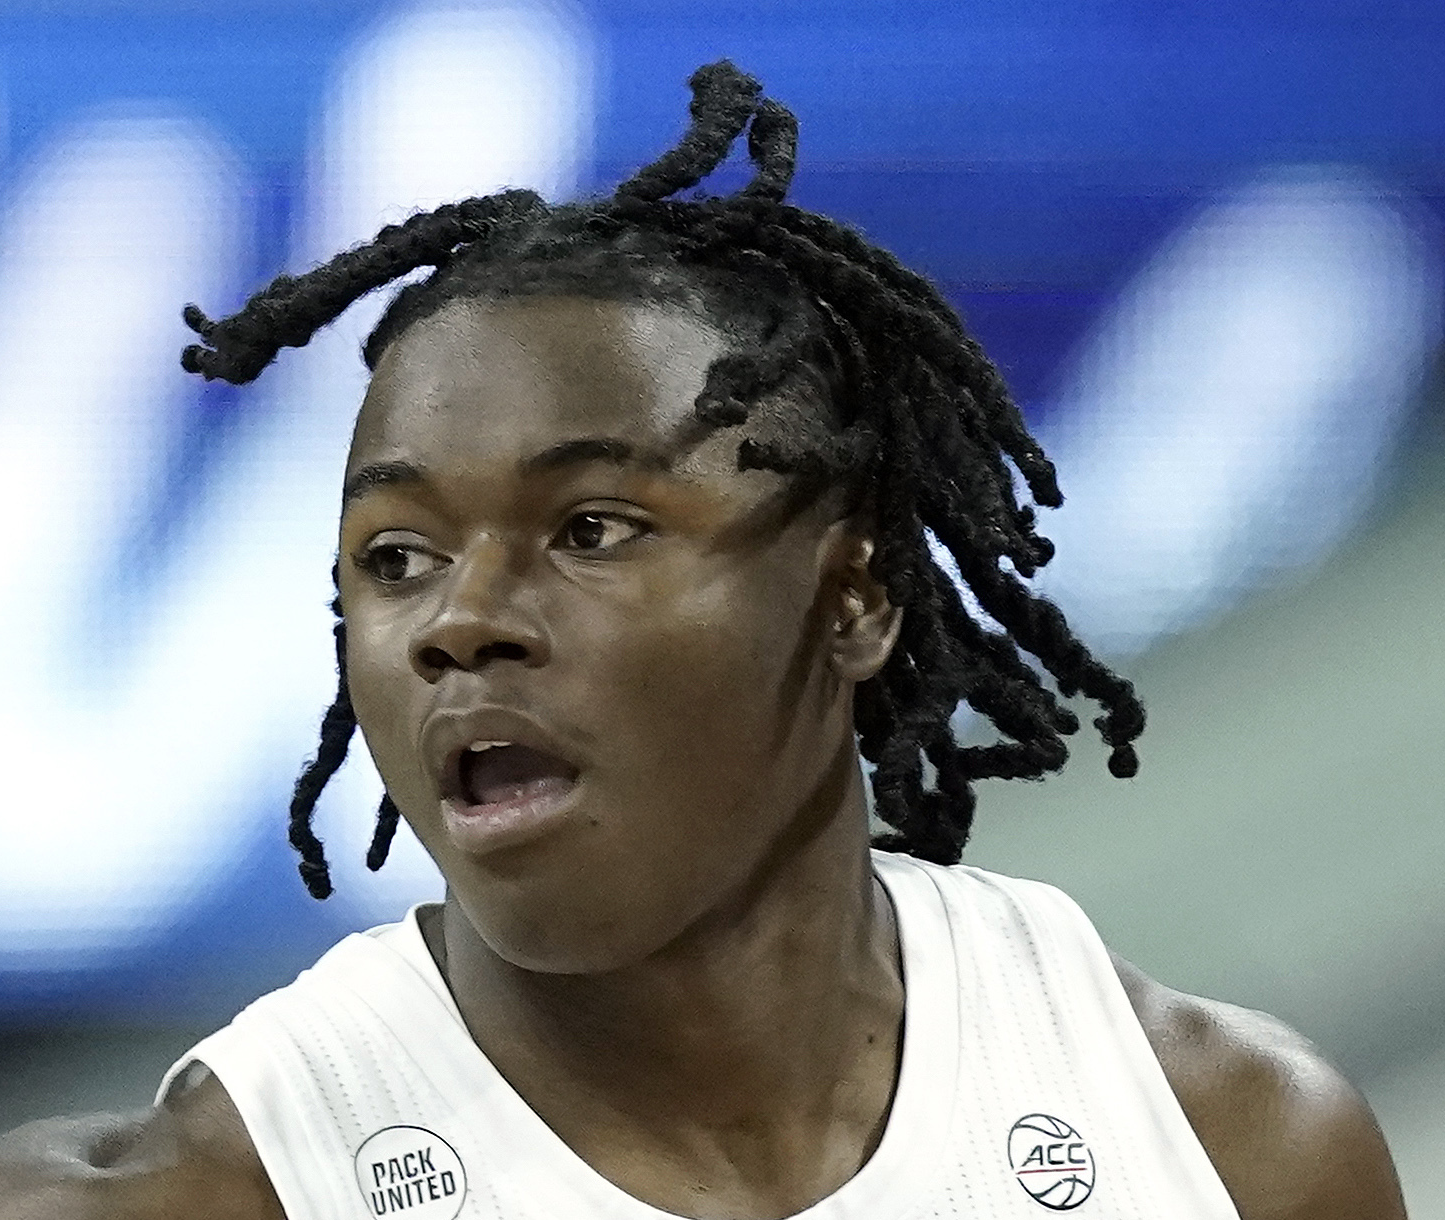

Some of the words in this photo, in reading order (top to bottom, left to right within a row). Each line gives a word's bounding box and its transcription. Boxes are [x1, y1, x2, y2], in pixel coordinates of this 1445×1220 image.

[371, 1147, 436, 1188] PACK
[1021, 1142, 1086, 1167] ACC
[371, 1170, 456, 1216] UNITED
